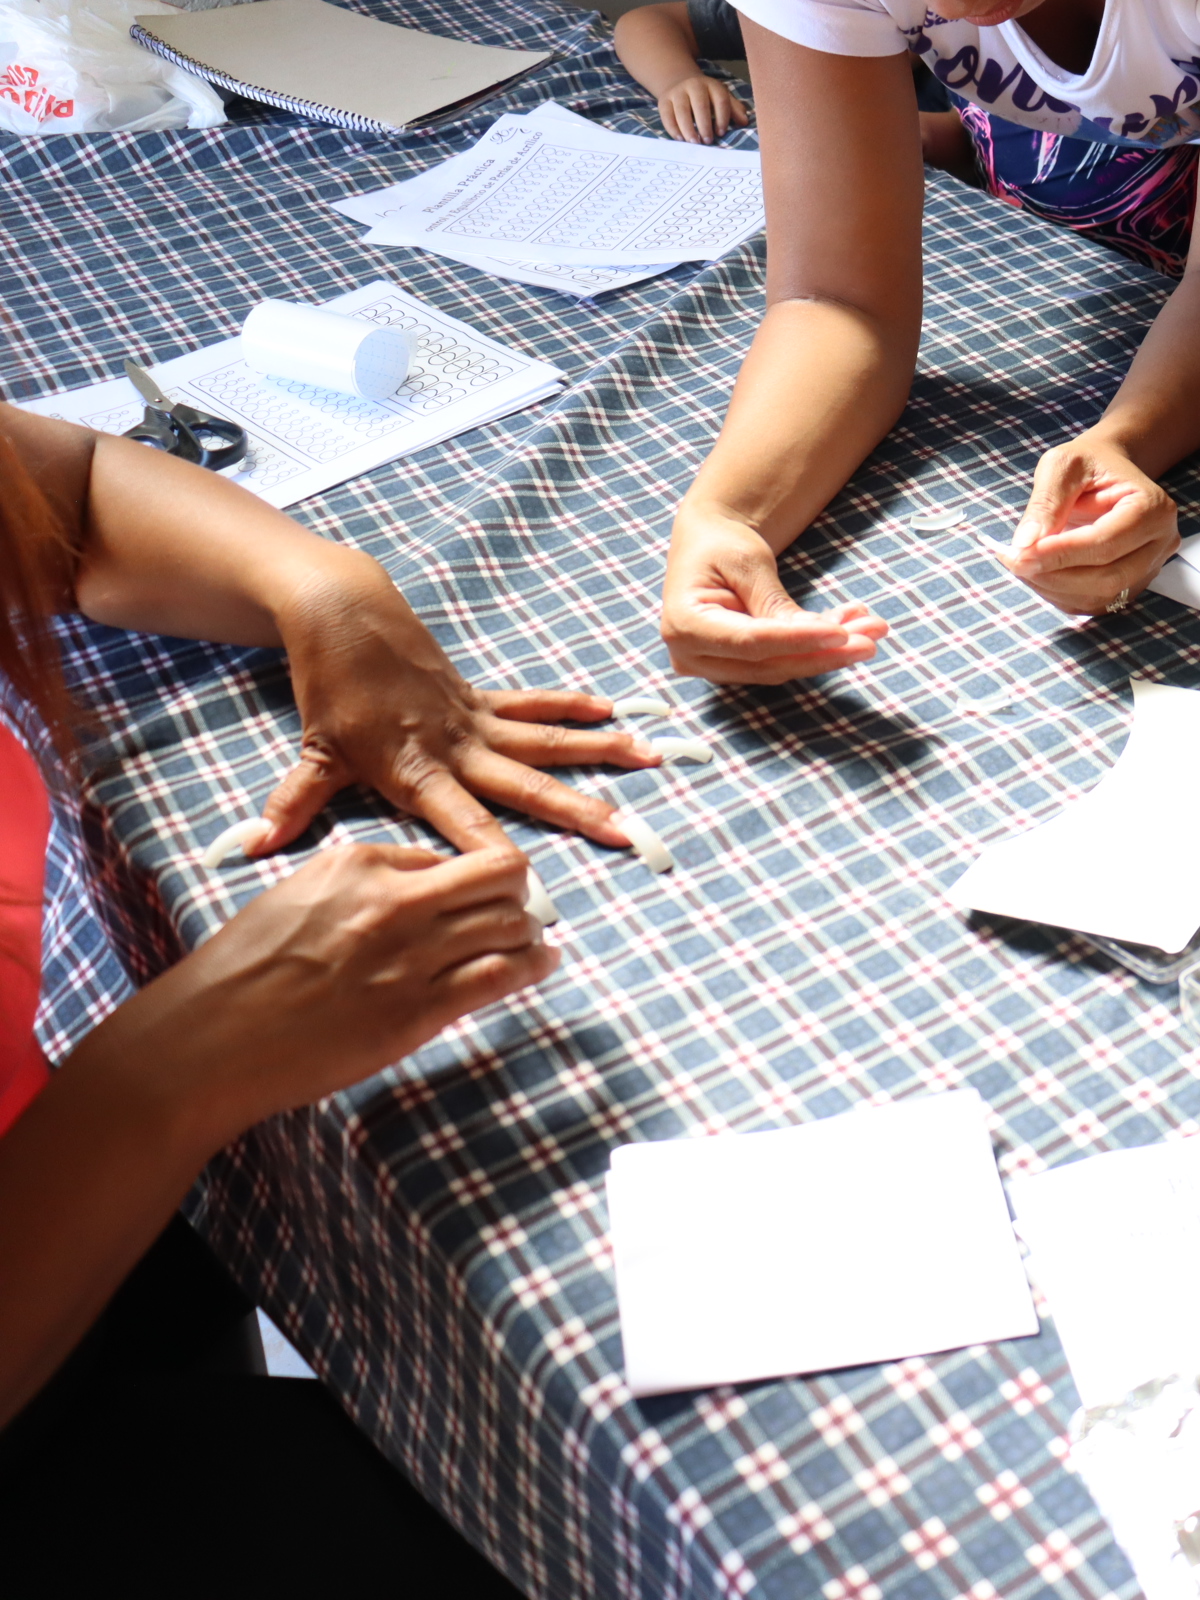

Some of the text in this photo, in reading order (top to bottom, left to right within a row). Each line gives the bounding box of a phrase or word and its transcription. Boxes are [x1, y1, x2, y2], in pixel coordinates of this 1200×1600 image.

[422, 158, 496, 213] Plantilla Práctica
[424, 213, 449, 232] ontrol
[452, 189, 487, 214] Equilibrio
[489, 164, 514, 181] Perlas
[516, 131, 543, 156] Acrílico
